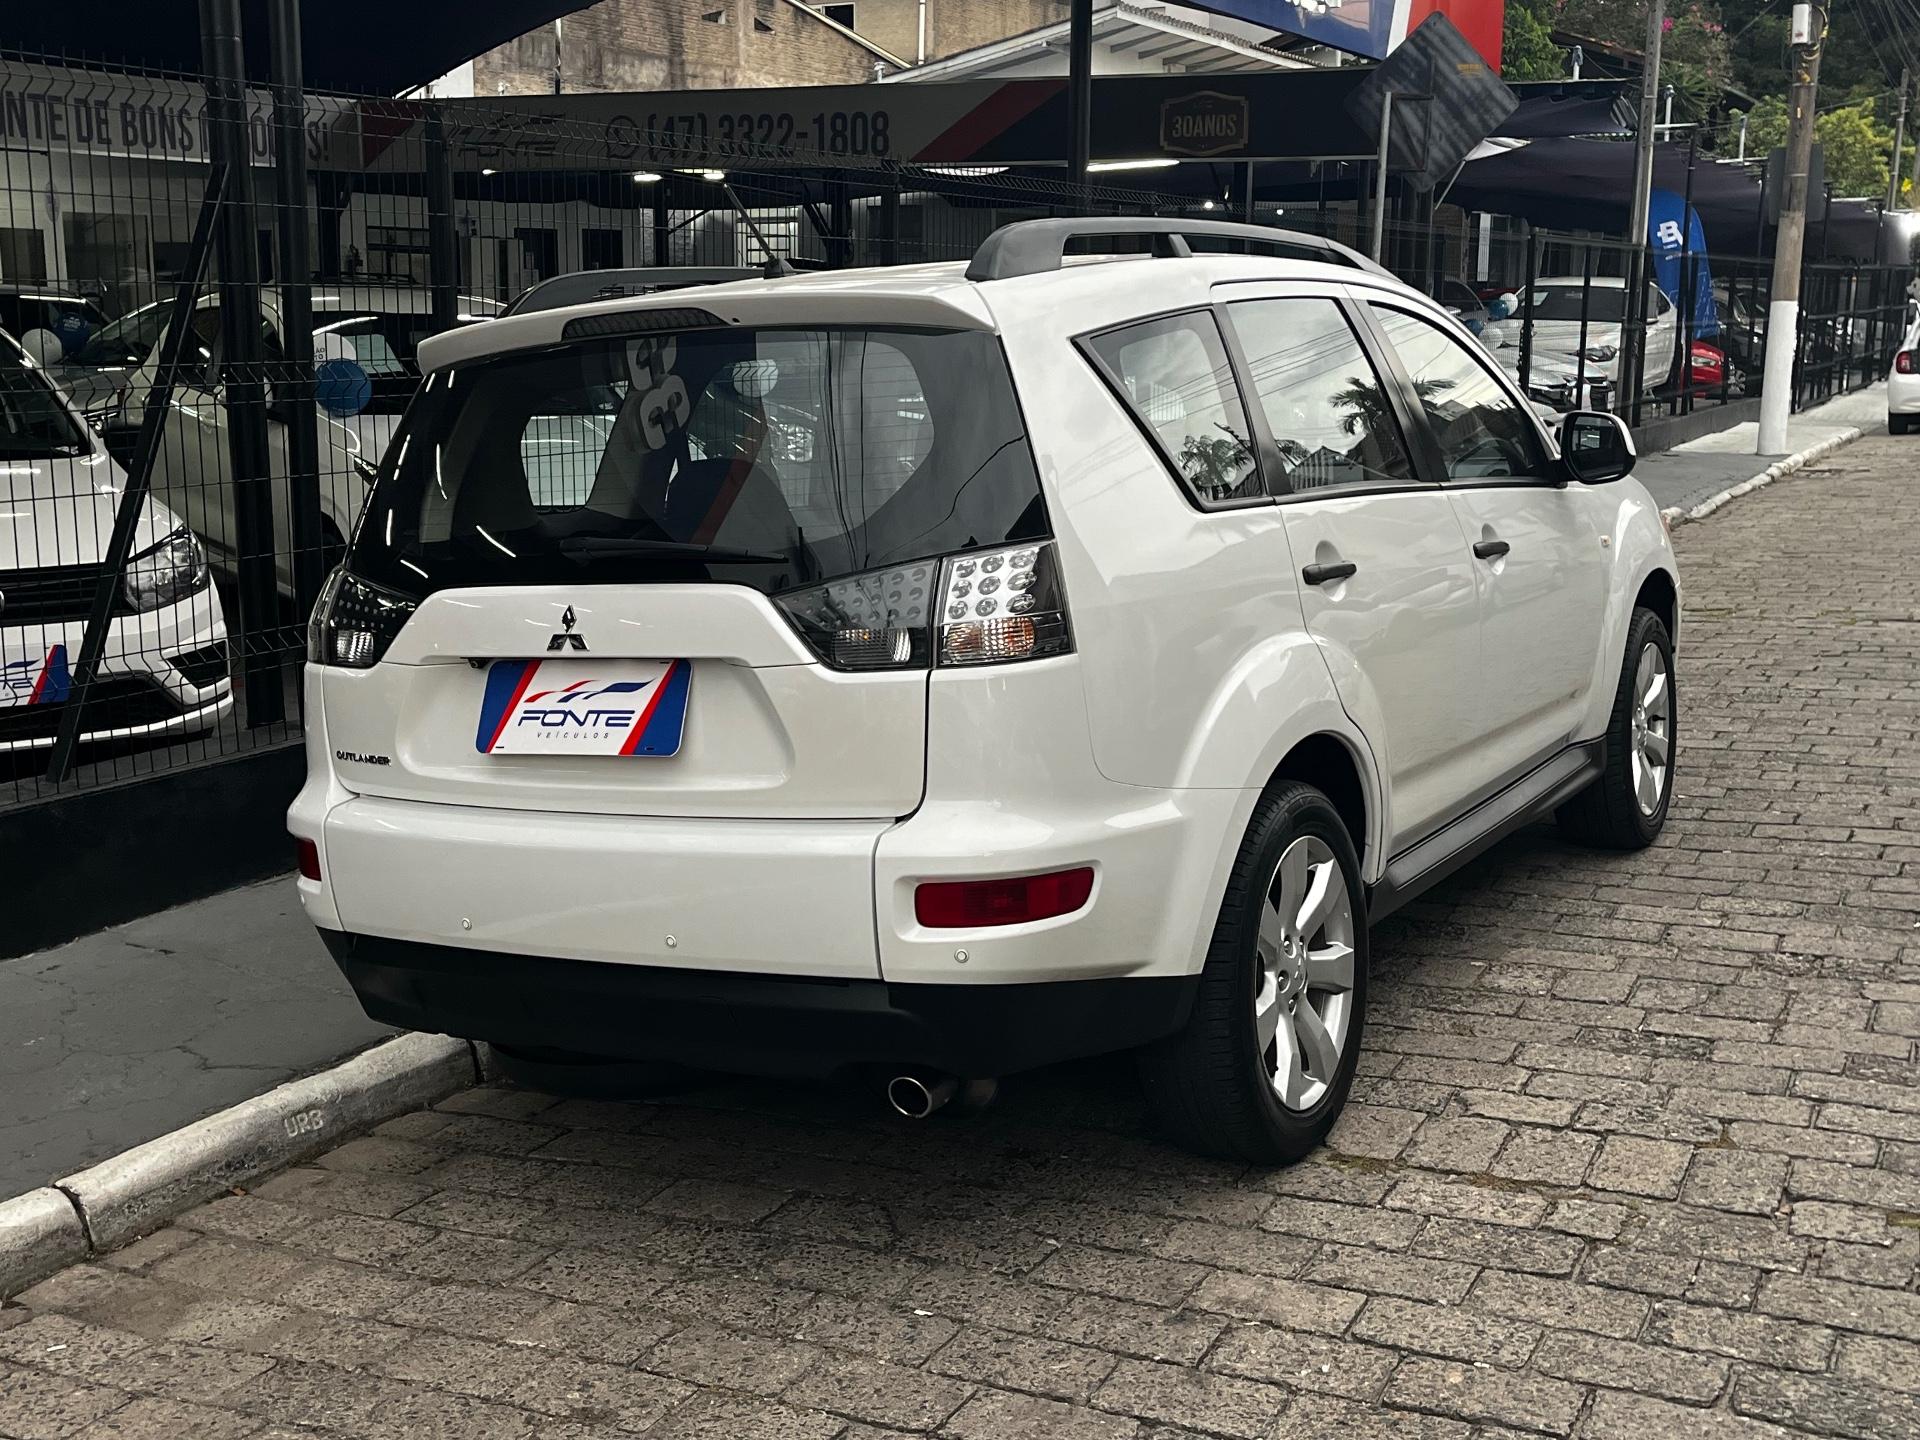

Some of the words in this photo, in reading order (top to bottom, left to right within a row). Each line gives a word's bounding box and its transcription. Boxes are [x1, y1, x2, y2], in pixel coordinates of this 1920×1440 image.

[74, 97, 112, 145] DE
[119, 102, 194, 152] BONS
[647, 112, 708, 162] (47)
[718, 110, 890, 159] 3322-1808
[518, 709, 636, 727] FONTE
[336, 750, 392, 766] OUTLANDER
[284, 1109, 324, 1137] URB
